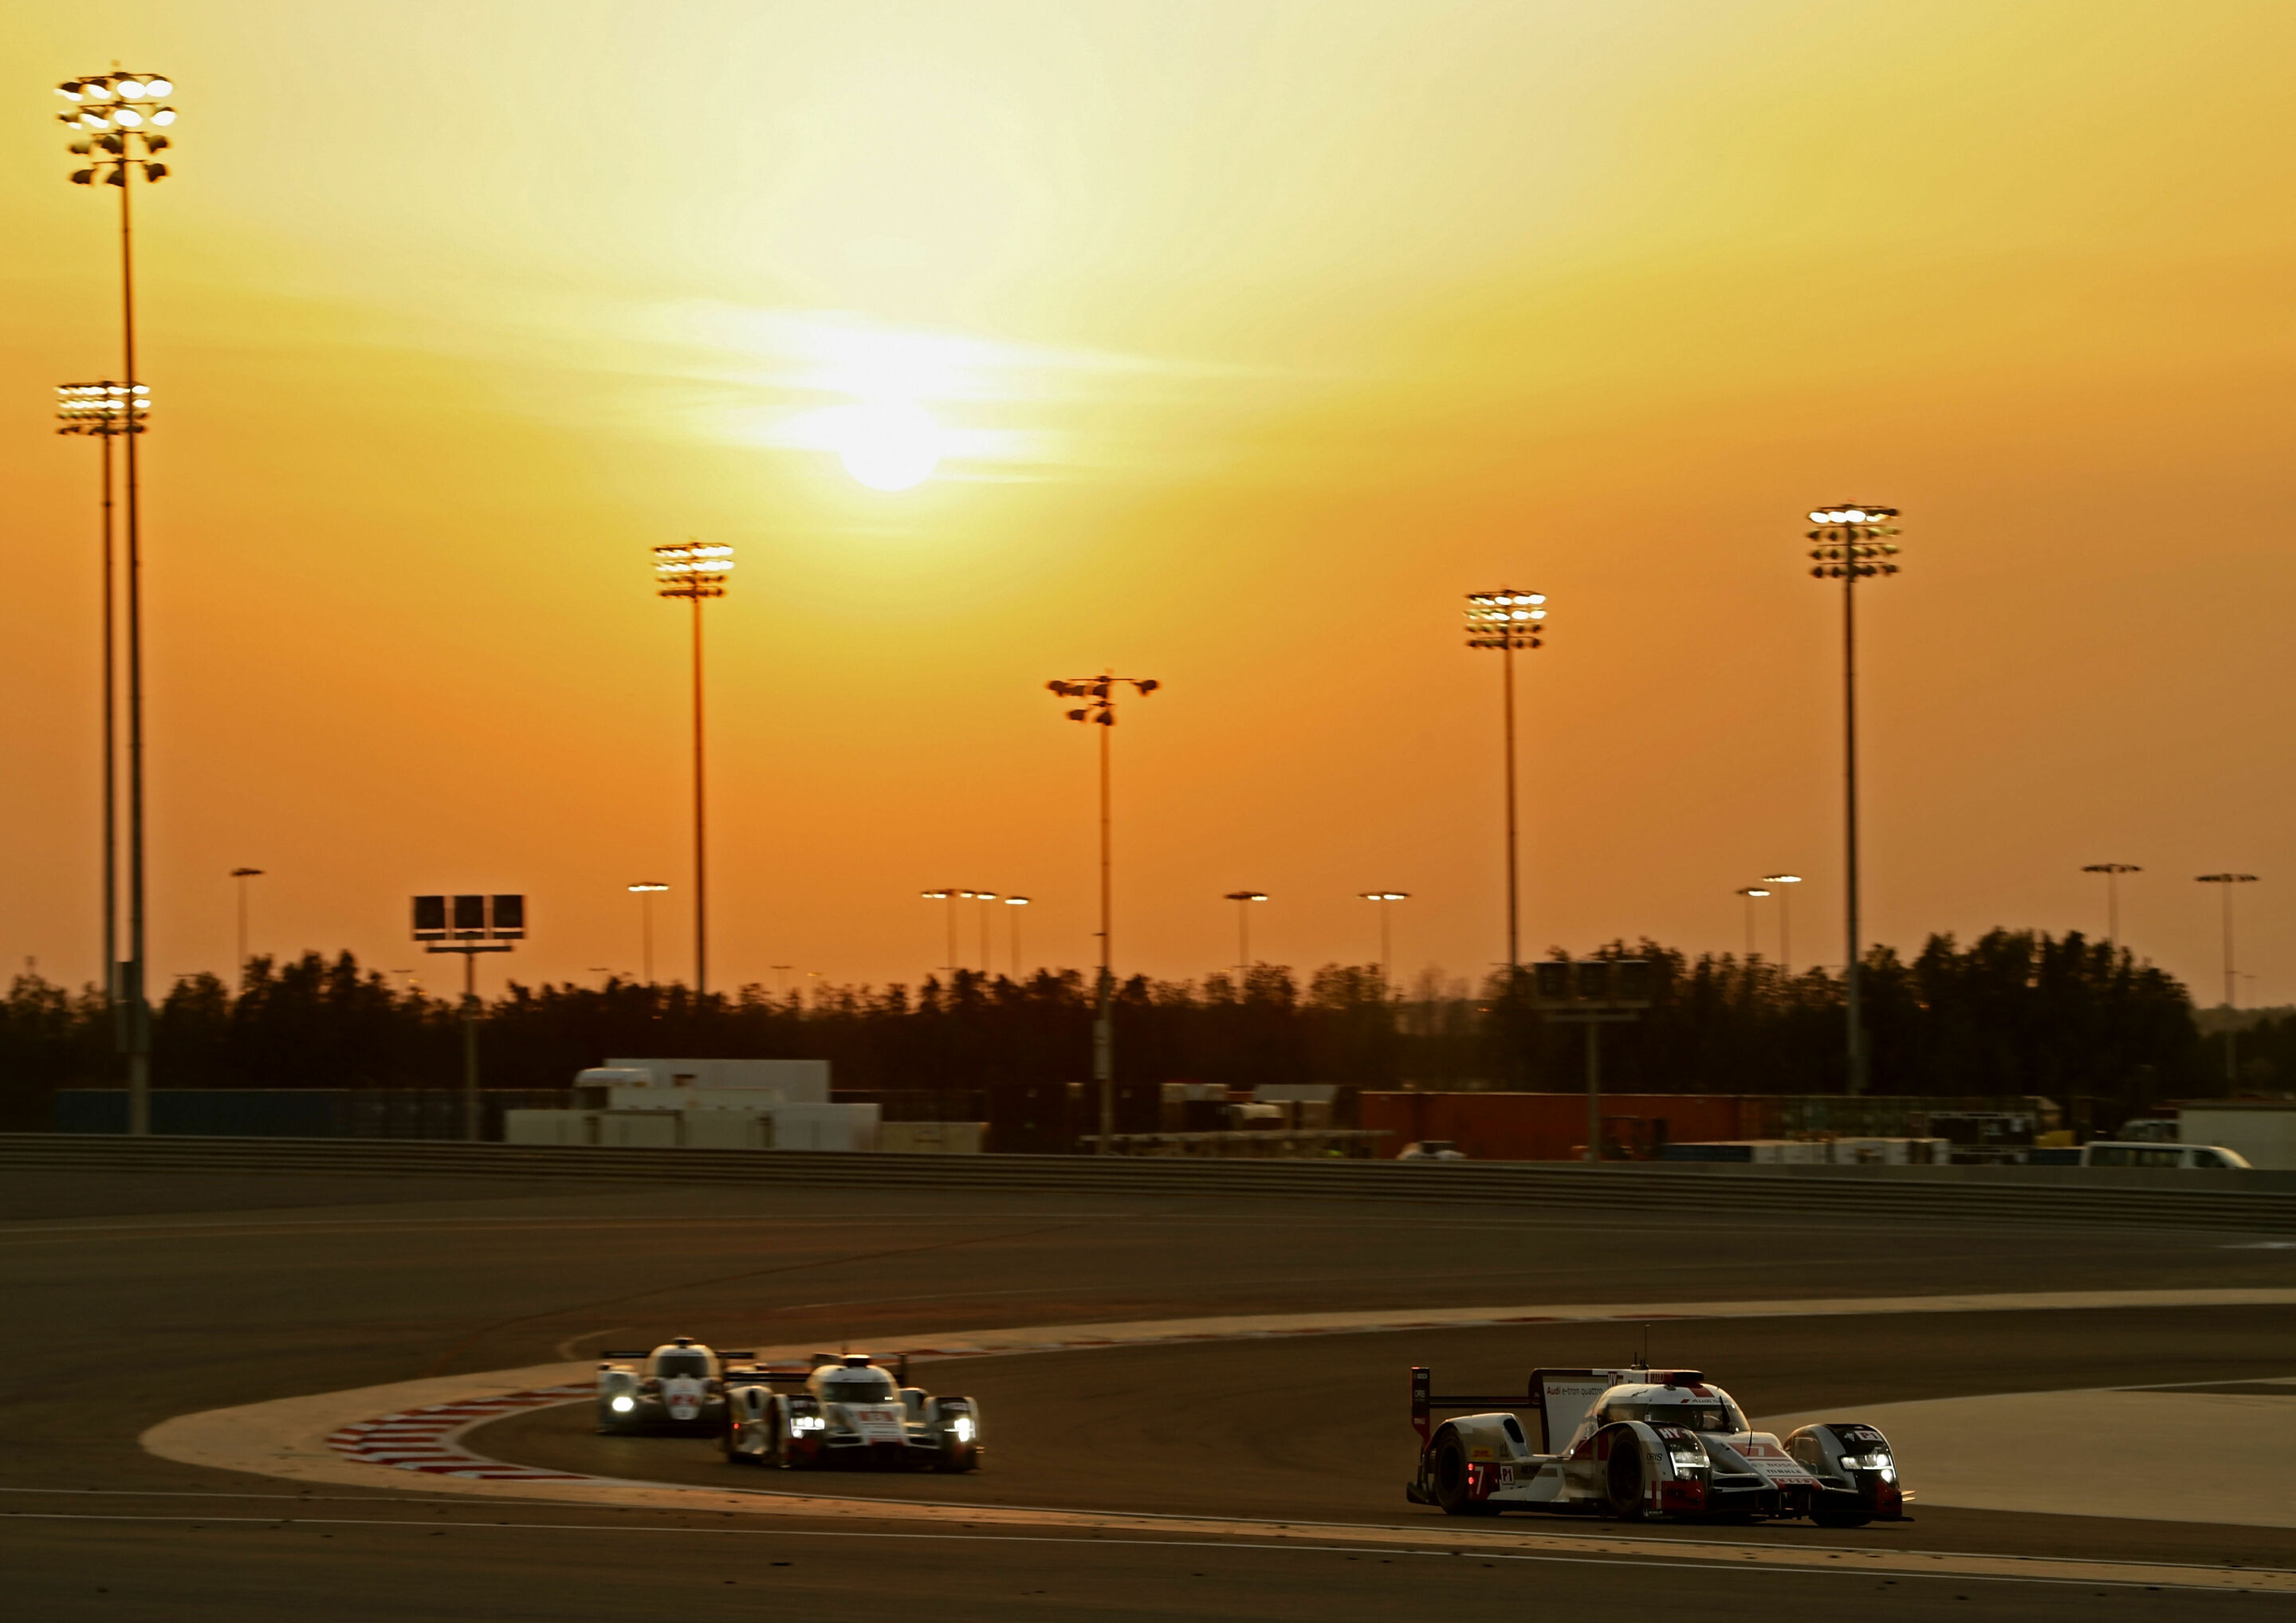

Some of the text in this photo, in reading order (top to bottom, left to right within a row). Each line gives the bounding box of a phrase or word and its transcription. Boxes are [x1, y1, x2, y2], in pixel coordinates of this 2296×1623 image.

[1547, 1386, 1560, 1395] Audi
[1659, 1428, 1681, 1439] HY
[1474, 1466, 1484, 1495] 7
[1502, 1468, 1513, 1482] P1
